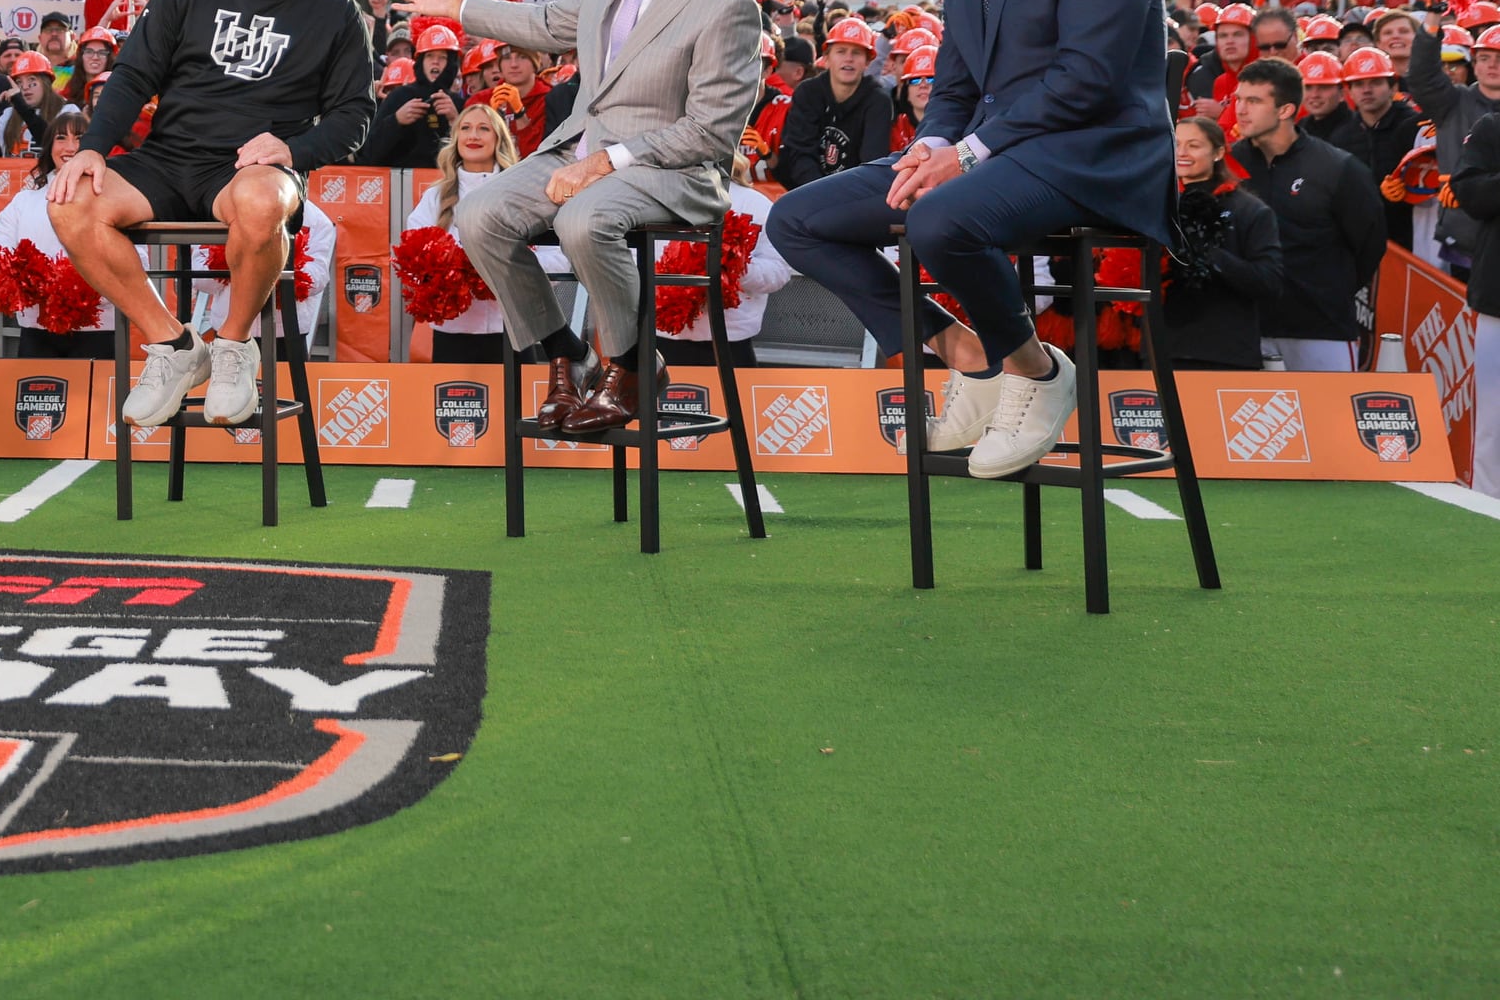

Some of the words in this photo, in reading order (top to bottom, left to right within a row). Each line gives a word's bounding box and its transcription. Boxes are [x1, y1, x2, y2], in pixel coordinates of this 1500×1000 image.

[16, 402, 65, 412] GAMEDAY
[23, 395, 60, 403] COLLEGE
[325, 387, 355, 413] THE
[442, 401, 481, 409] COLLEGE
[662, 403, 702, 412] COLLEGE
[762, 393, 791, 420] THE
[1230, 397, 1261, 427] THE
[319, 380, 388, 446] HOME
[346, 405, 388, 447] DEPOT
[436, 408, 487, 418] GAMEDAY
[756, 387, 828, 454] HOME
[1119, 410, 1162, 418] COLLEGE
[1227, 391, 1300, 460] HOME
[1357, 420, 1416, 431] GAMEDAY
[1362, 412, 1409, 421] COLLEGE
[785, 412, 829, 454] DEPOT
[1259, 418, 1304, 462] DEPOT
